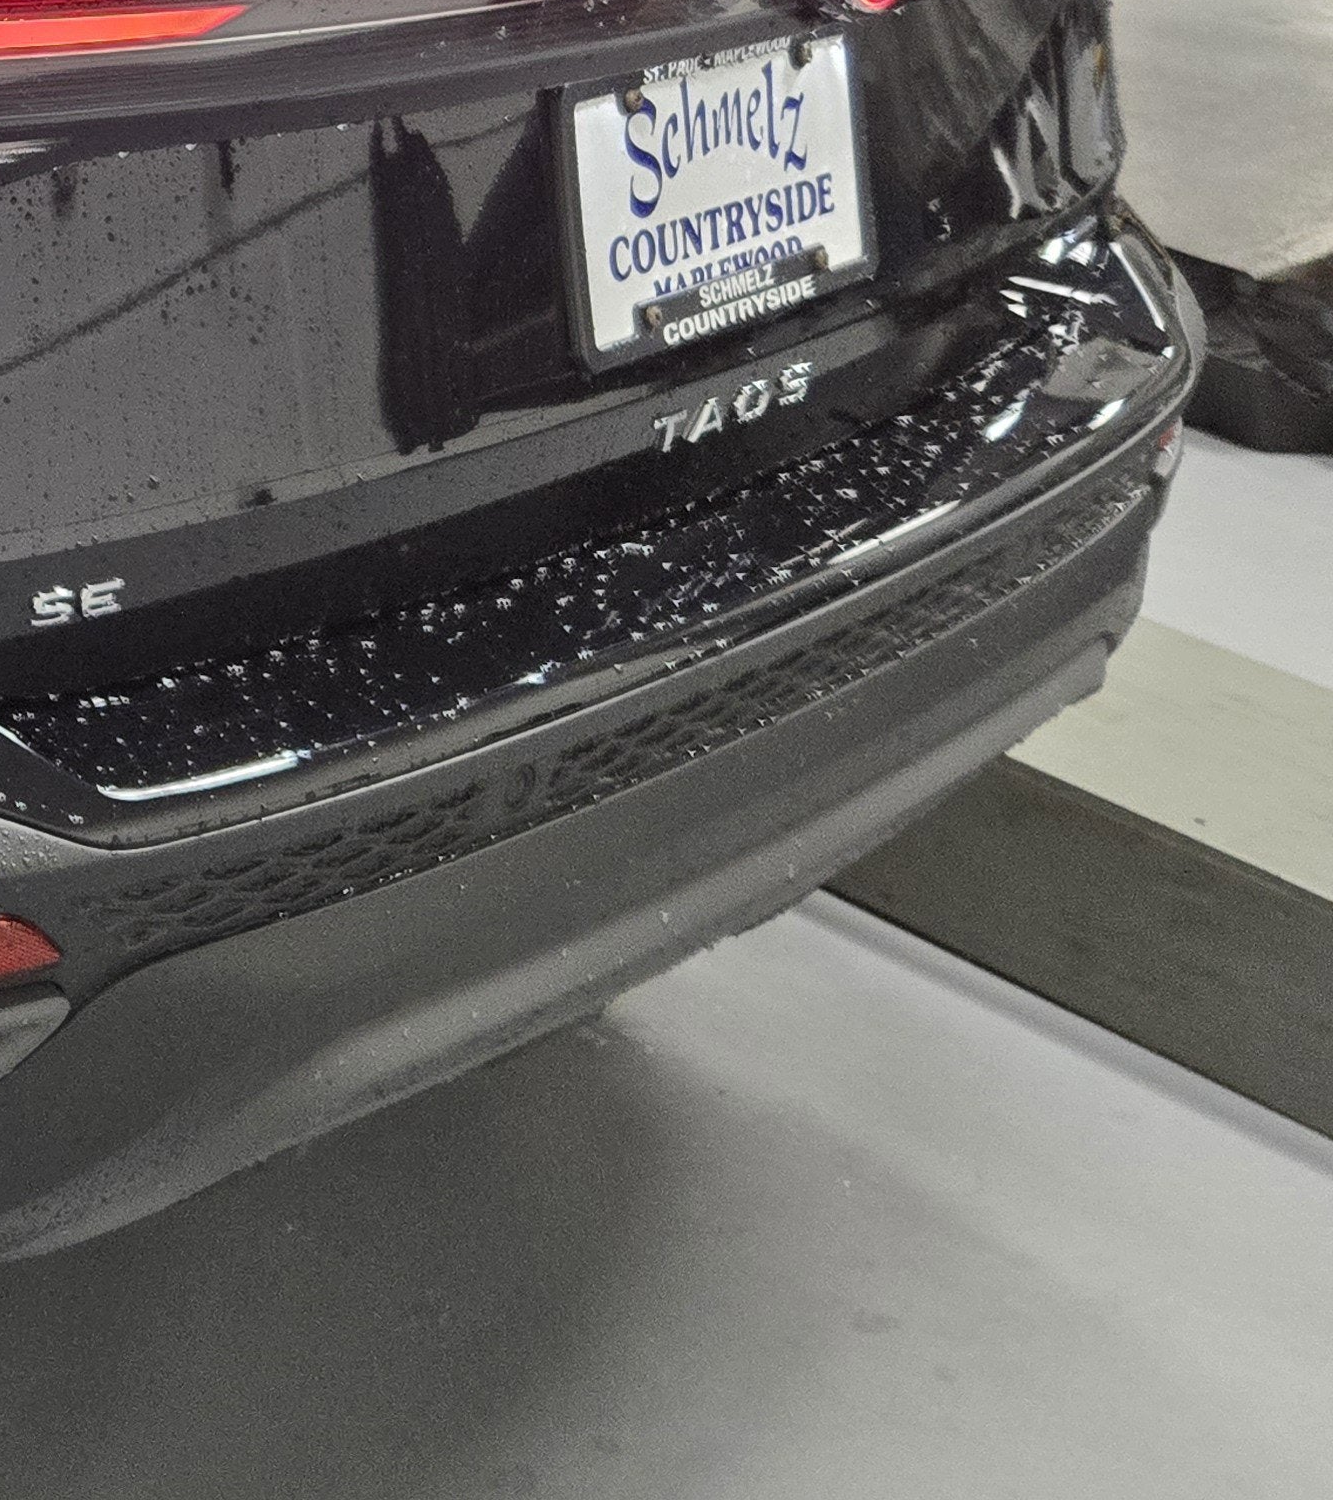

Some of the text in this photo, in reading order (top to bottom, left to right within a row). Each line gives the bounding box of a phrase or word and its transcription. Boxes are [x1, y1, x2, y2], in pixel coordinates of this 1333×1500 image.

[667, 54, 703, 80] PAUL
[713, 34, 792, 68] MAPLEWOOD
[624, 61, 809, 218] Schmelz
[609, 172, 835, 282] COUNTRYSIDE
[662, 273, 817, 347] COUNTRYSIDE
[698, 263, 776, 308] SCHMELZ
[653, 361, 813, 453] TAOS
[30, 576, 126, 627] SE
